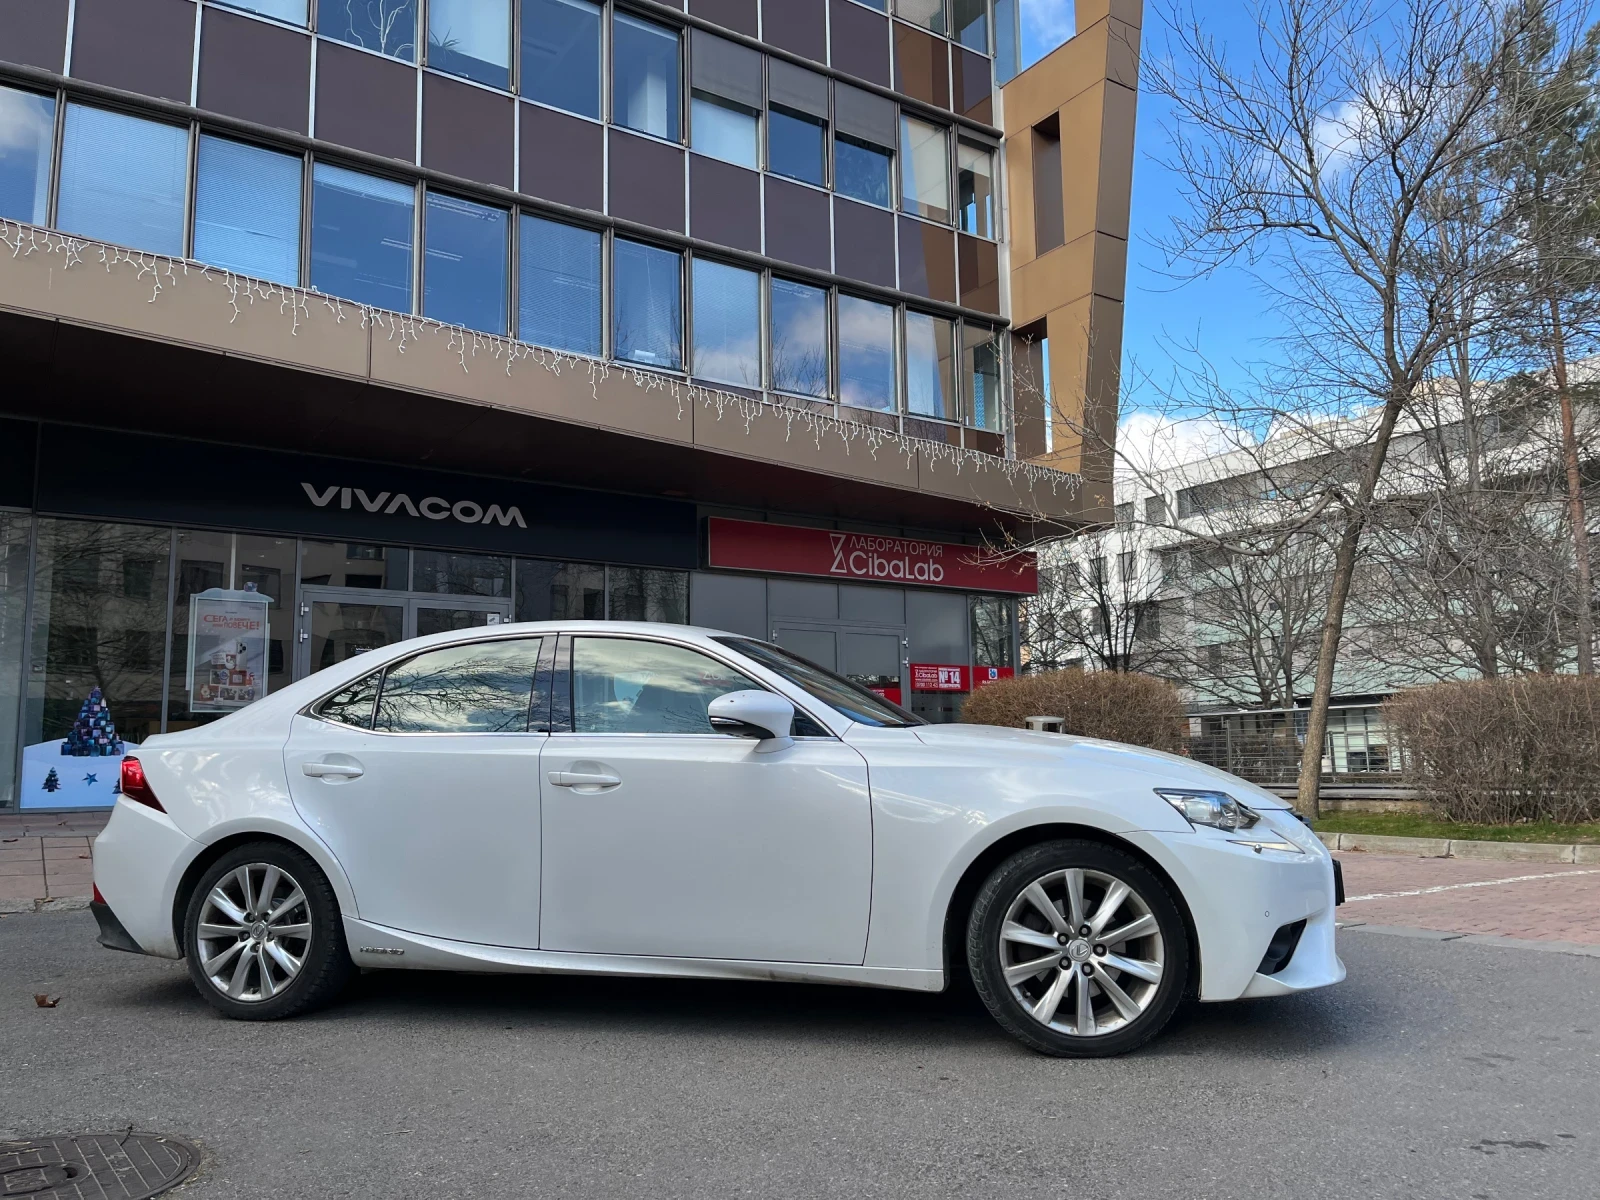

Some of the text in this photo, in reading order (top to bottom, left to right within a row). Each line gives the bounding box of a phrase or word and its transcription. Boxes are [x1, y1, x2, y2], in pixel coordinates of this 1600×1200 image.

[300, 482, 528, 529] VIVACOM
[849, 535, 943, 557] ЛАБОРАТОРИЯ
[849, 550, 945, 582] CibaLab
[203, 614, 228, 623] СЕГА
[949, 671, 960, 684] 14
